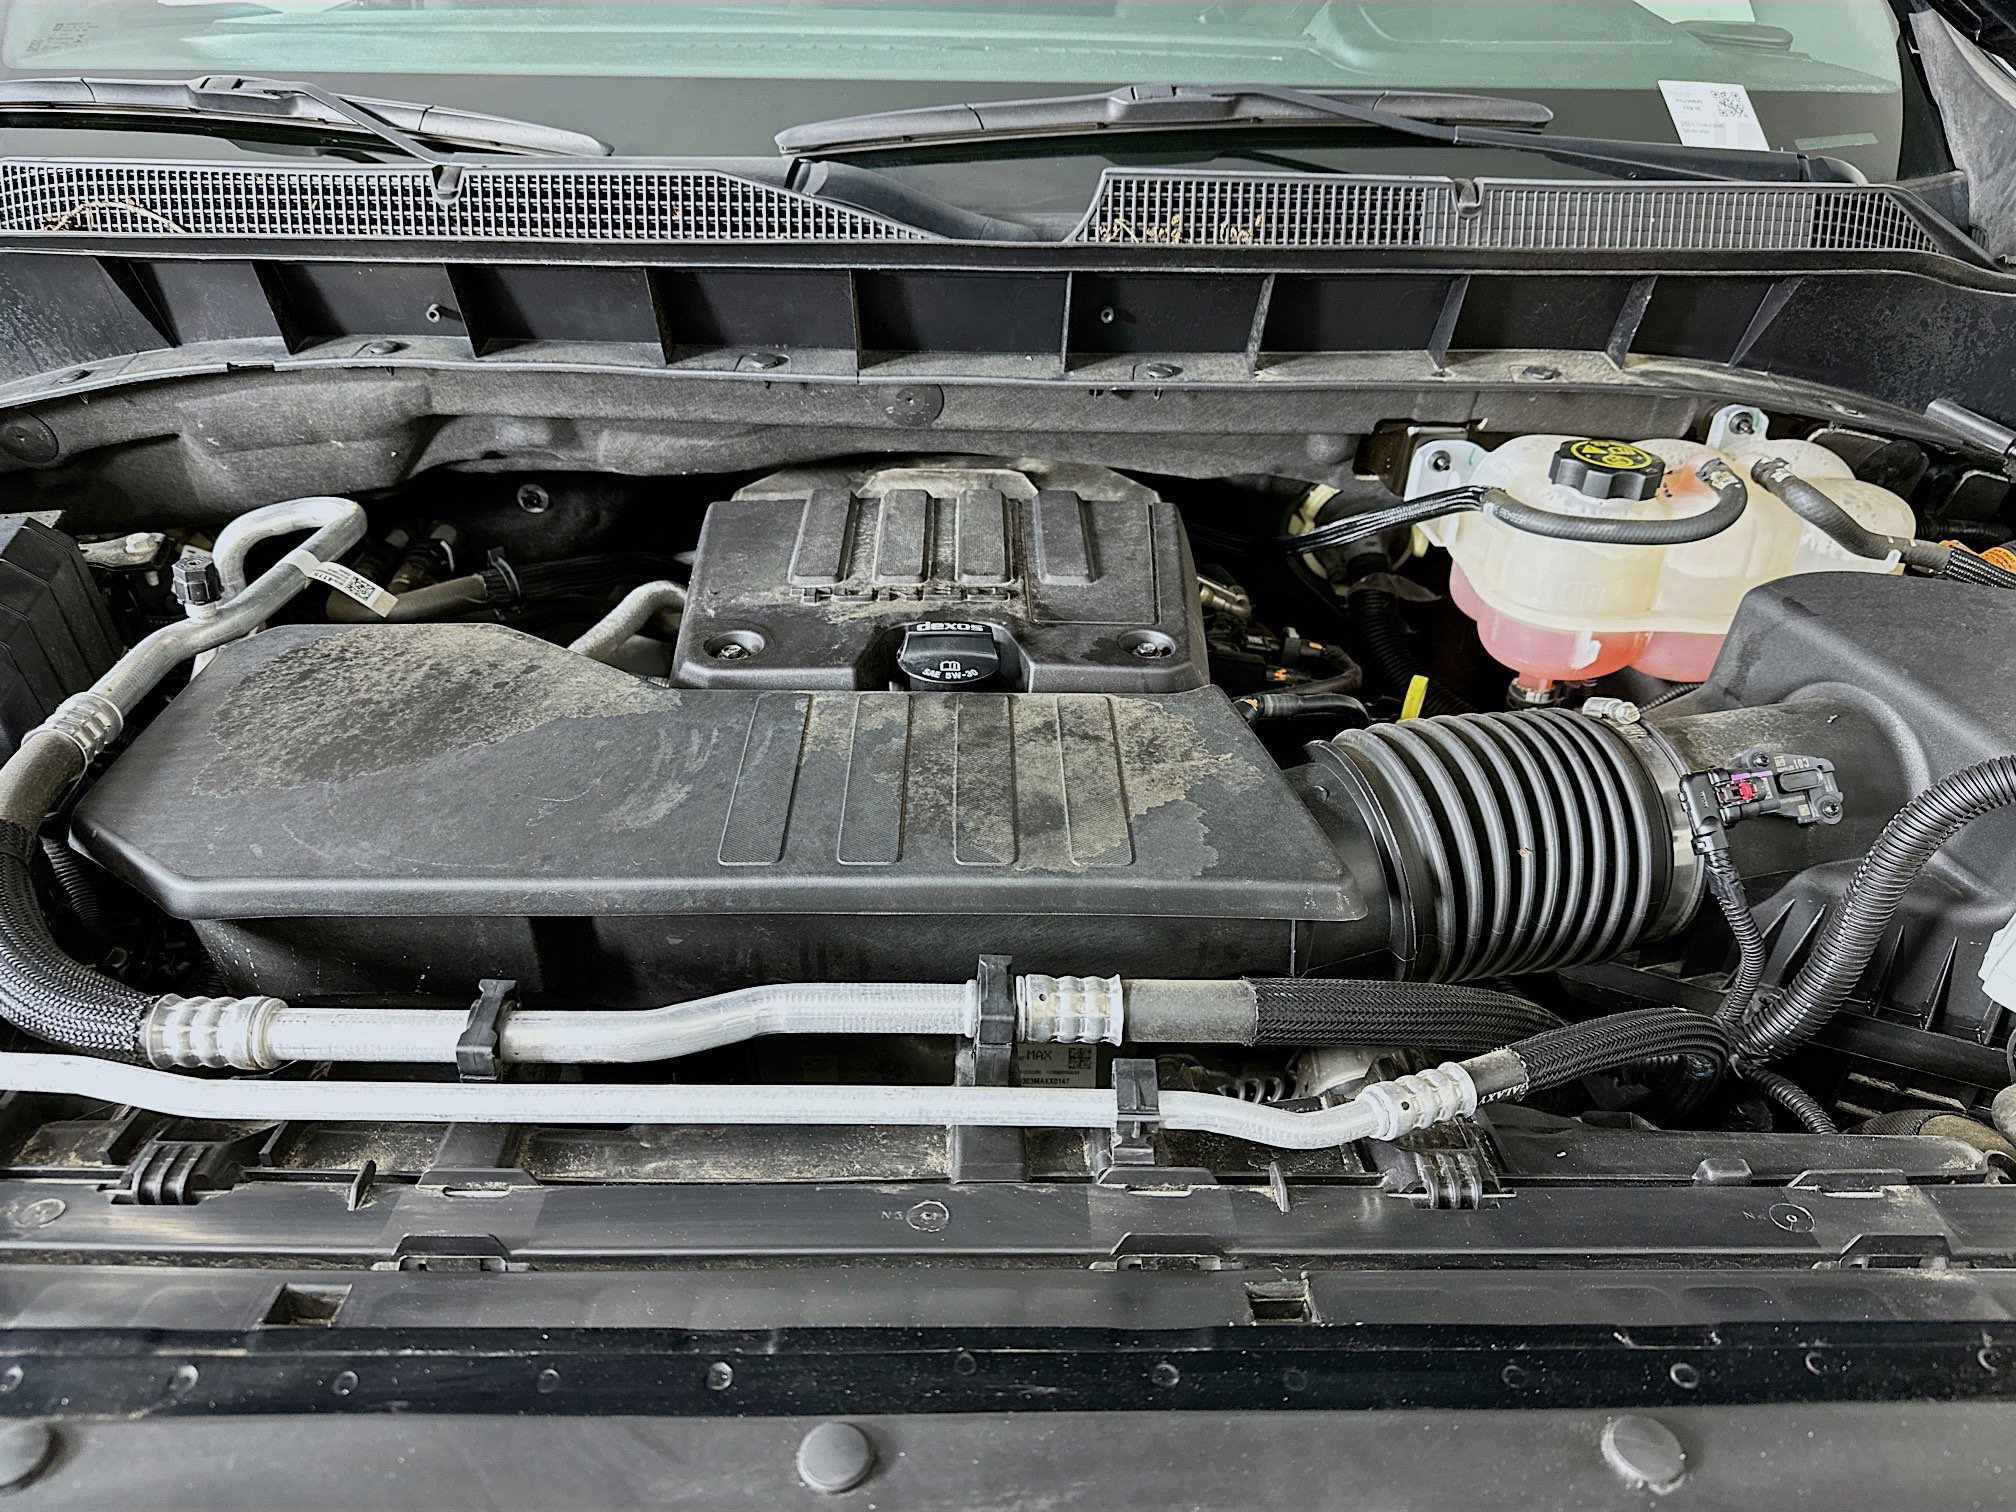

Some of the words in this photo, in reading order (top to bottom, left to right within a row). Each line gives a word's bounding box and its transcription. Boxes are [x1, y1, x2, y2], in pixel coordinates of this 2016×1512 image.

[916, 621, 984, 632] dexos
[921, 668, 942, 679] SAE
[944, 668, 979, 680] 5W-30
[1027, 1050, 1052, 1060] MAX
